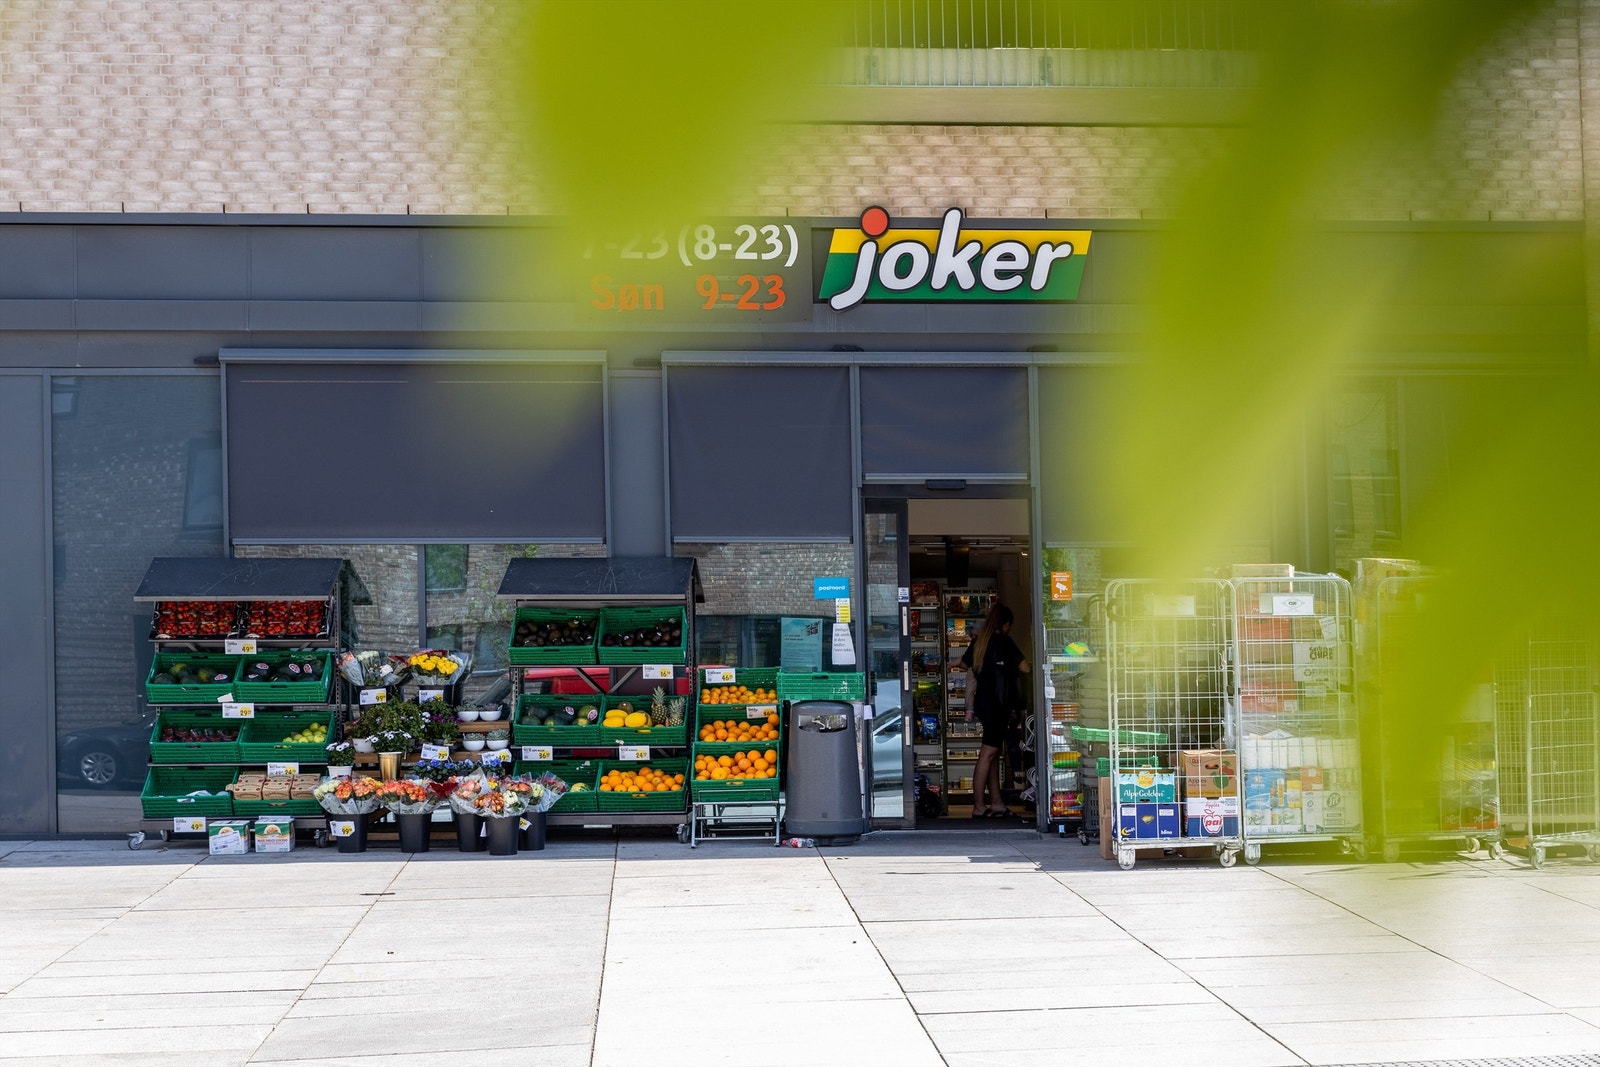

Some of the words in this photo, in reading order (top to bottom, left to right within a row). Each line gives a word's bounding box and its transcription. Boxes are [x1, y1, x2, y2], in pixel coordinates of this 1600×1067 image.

[678, 224, 799, 267] (8-23)
[828, 205, 1073, 312] joker
[591, 274, 664, 312] Søn
[696, 274, 786, 311] 9-23
[1188, 778, 1207, 786] Appes
